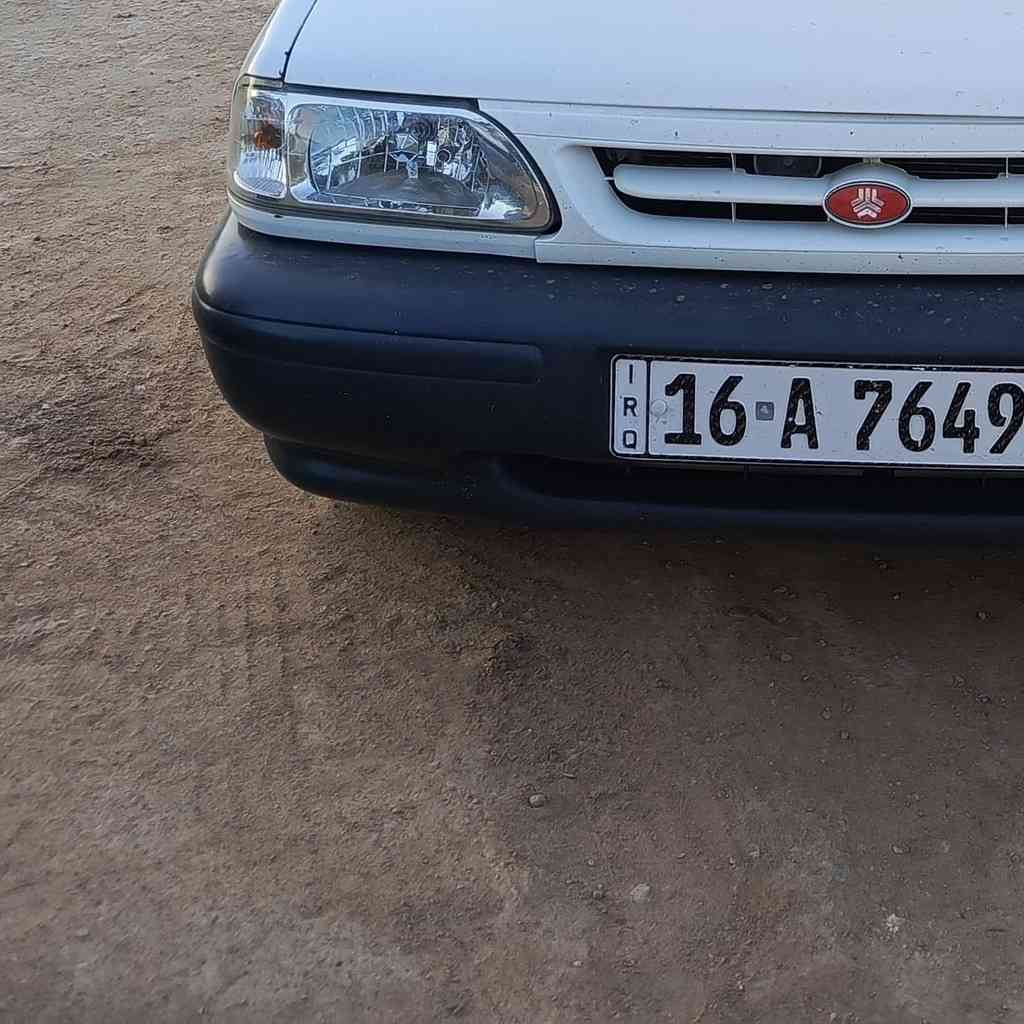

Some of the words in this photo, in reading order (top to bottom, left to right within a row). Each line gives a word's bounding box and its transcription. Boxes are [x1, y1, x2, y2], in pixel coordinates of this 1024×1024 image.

[623, 363, 638, 450] IRQ
[664, 373, 747, 446] 16
[780, 376, 820, 449] A
